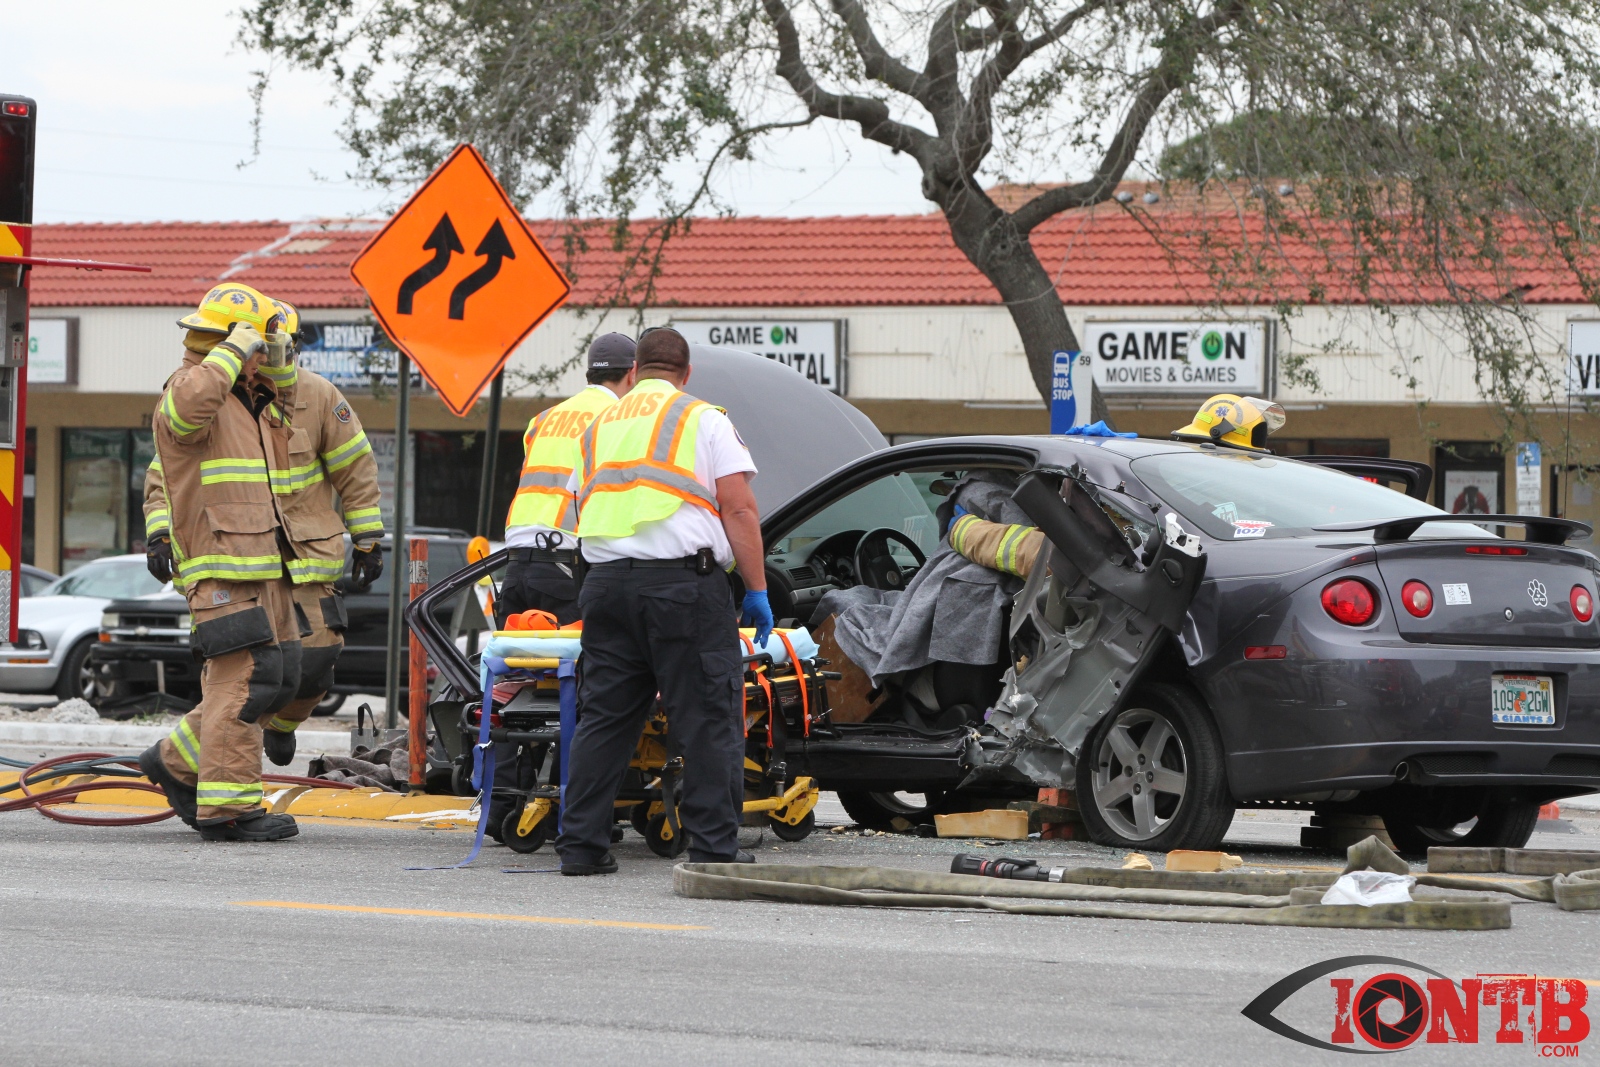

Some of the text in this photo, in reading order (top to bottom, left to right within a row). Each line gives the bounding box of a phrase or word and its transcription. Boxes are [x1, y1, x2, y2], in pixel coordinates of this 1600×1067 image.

[324, 325, 374, 348] BRYANT
[709, 327, 763, 345] GAME
[1098, 330, 1246, 361] GAME ON
[1079, 355, 1092, 366] 59
[1052, 377, 1070, 389] BUS
[1106, 367, 1237, 383] MOVIES & GAMES
[1052, 389, 1073, 401] STOP
[603, 392, 665, 425] EMS
[538, 410, 594, 439] EMS
[1493, 689, 1549, 713] 109 2GW
[1502, 715, 1544, 723] GIANTS
